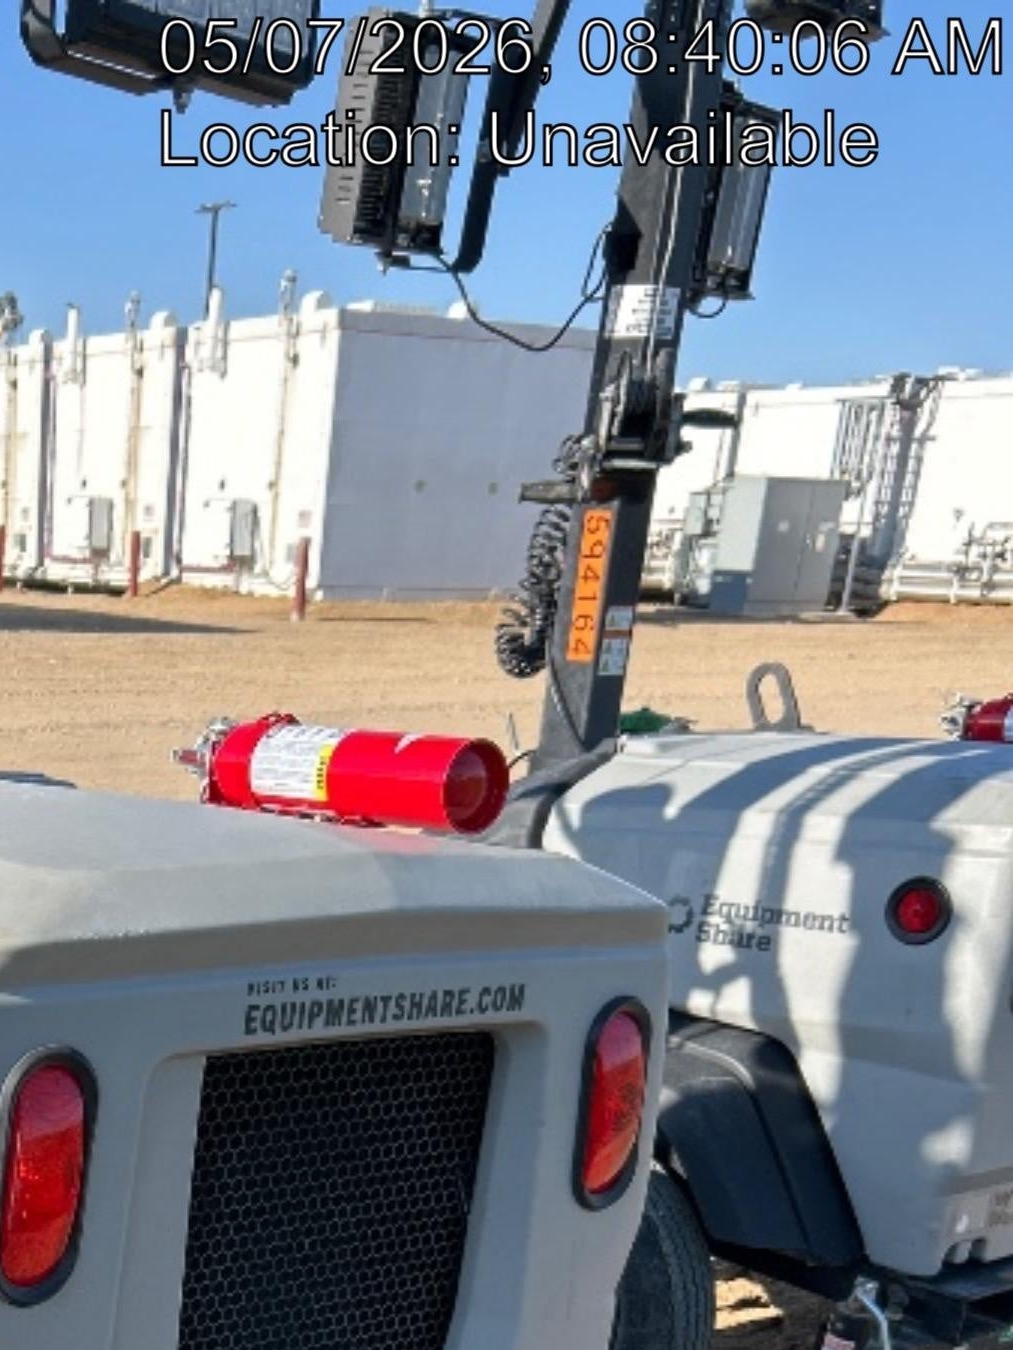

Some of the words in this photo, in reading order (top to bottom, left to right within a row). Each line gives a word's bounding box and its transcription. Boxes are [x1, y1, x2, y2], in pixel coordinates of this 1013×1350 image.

[571, 515, 610, 656] 594164
[695, 920, 771, 951] Share
[701, 893, 850, 934] Equipment
[244, 984, 527, 1036] EQUIPMENTSHARE.COM
